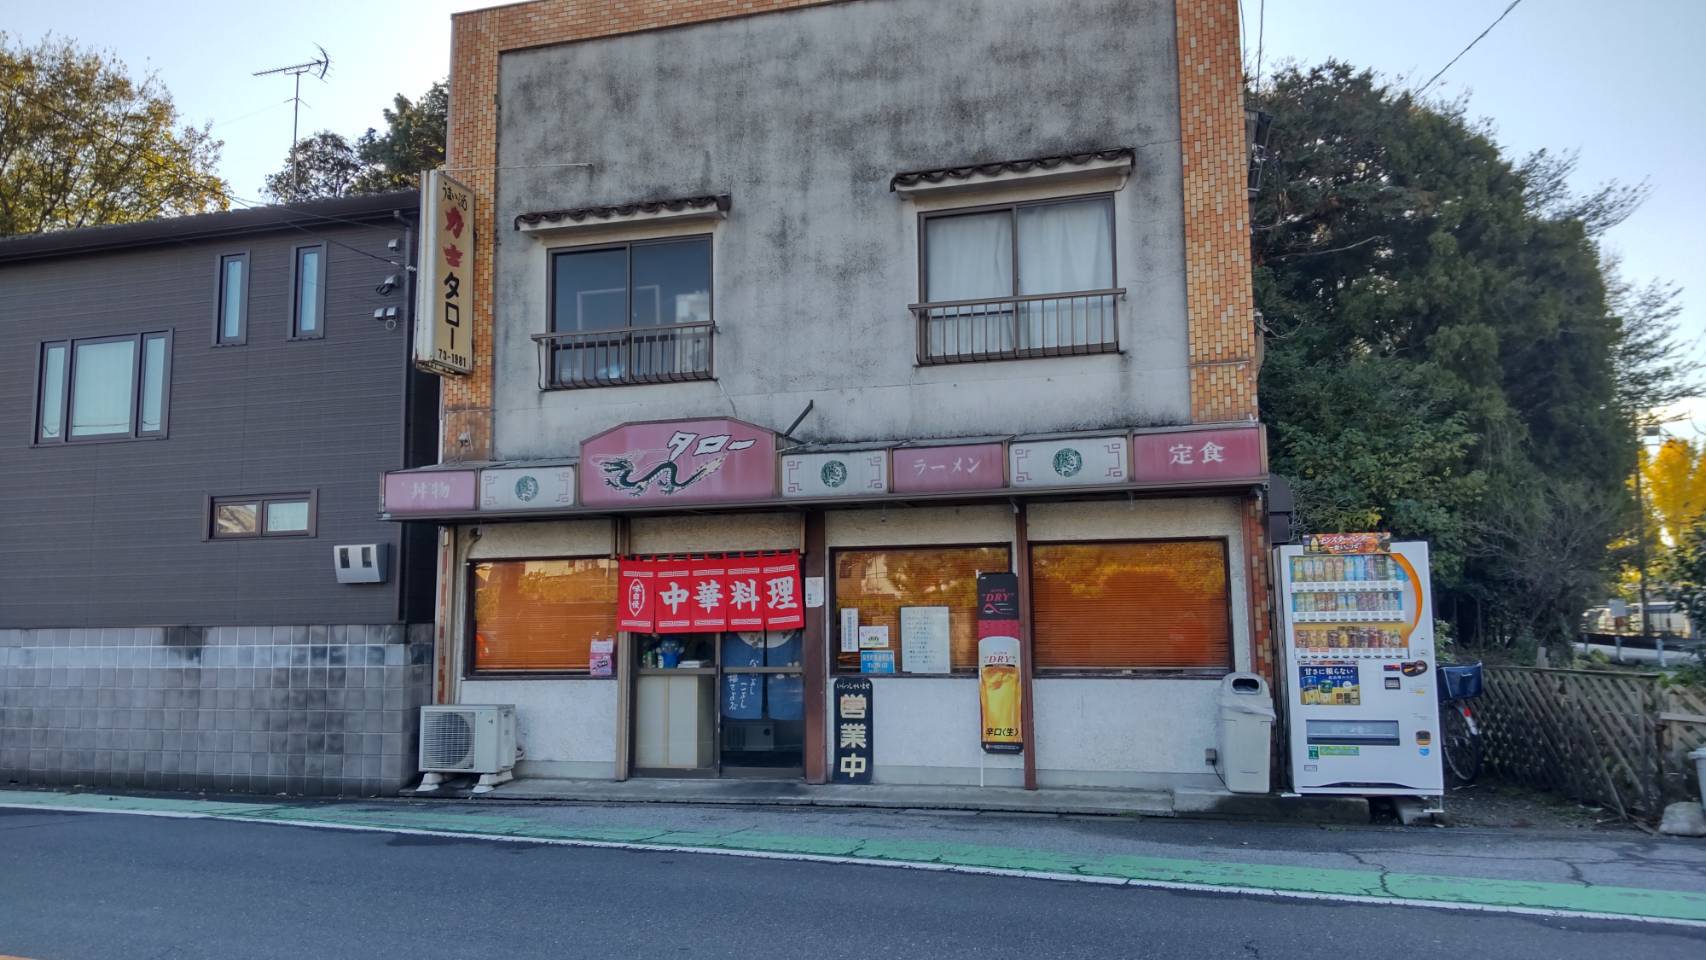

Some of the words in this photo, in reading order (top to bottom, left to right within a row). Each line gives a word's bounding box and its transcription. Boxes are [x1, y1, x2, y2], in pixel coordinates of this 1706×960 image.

[444, 271, 460, 350] タロー
[438, 348, 466, 368] 73-1981
[667, 430, 757, 463] タロー
[1168, 441, 1224, 464] 定食
[914, 458, 982, 475] ラーメン
[659, 576, 798, 615] 中華料理
[840, 694, 867, 778] 営業中
